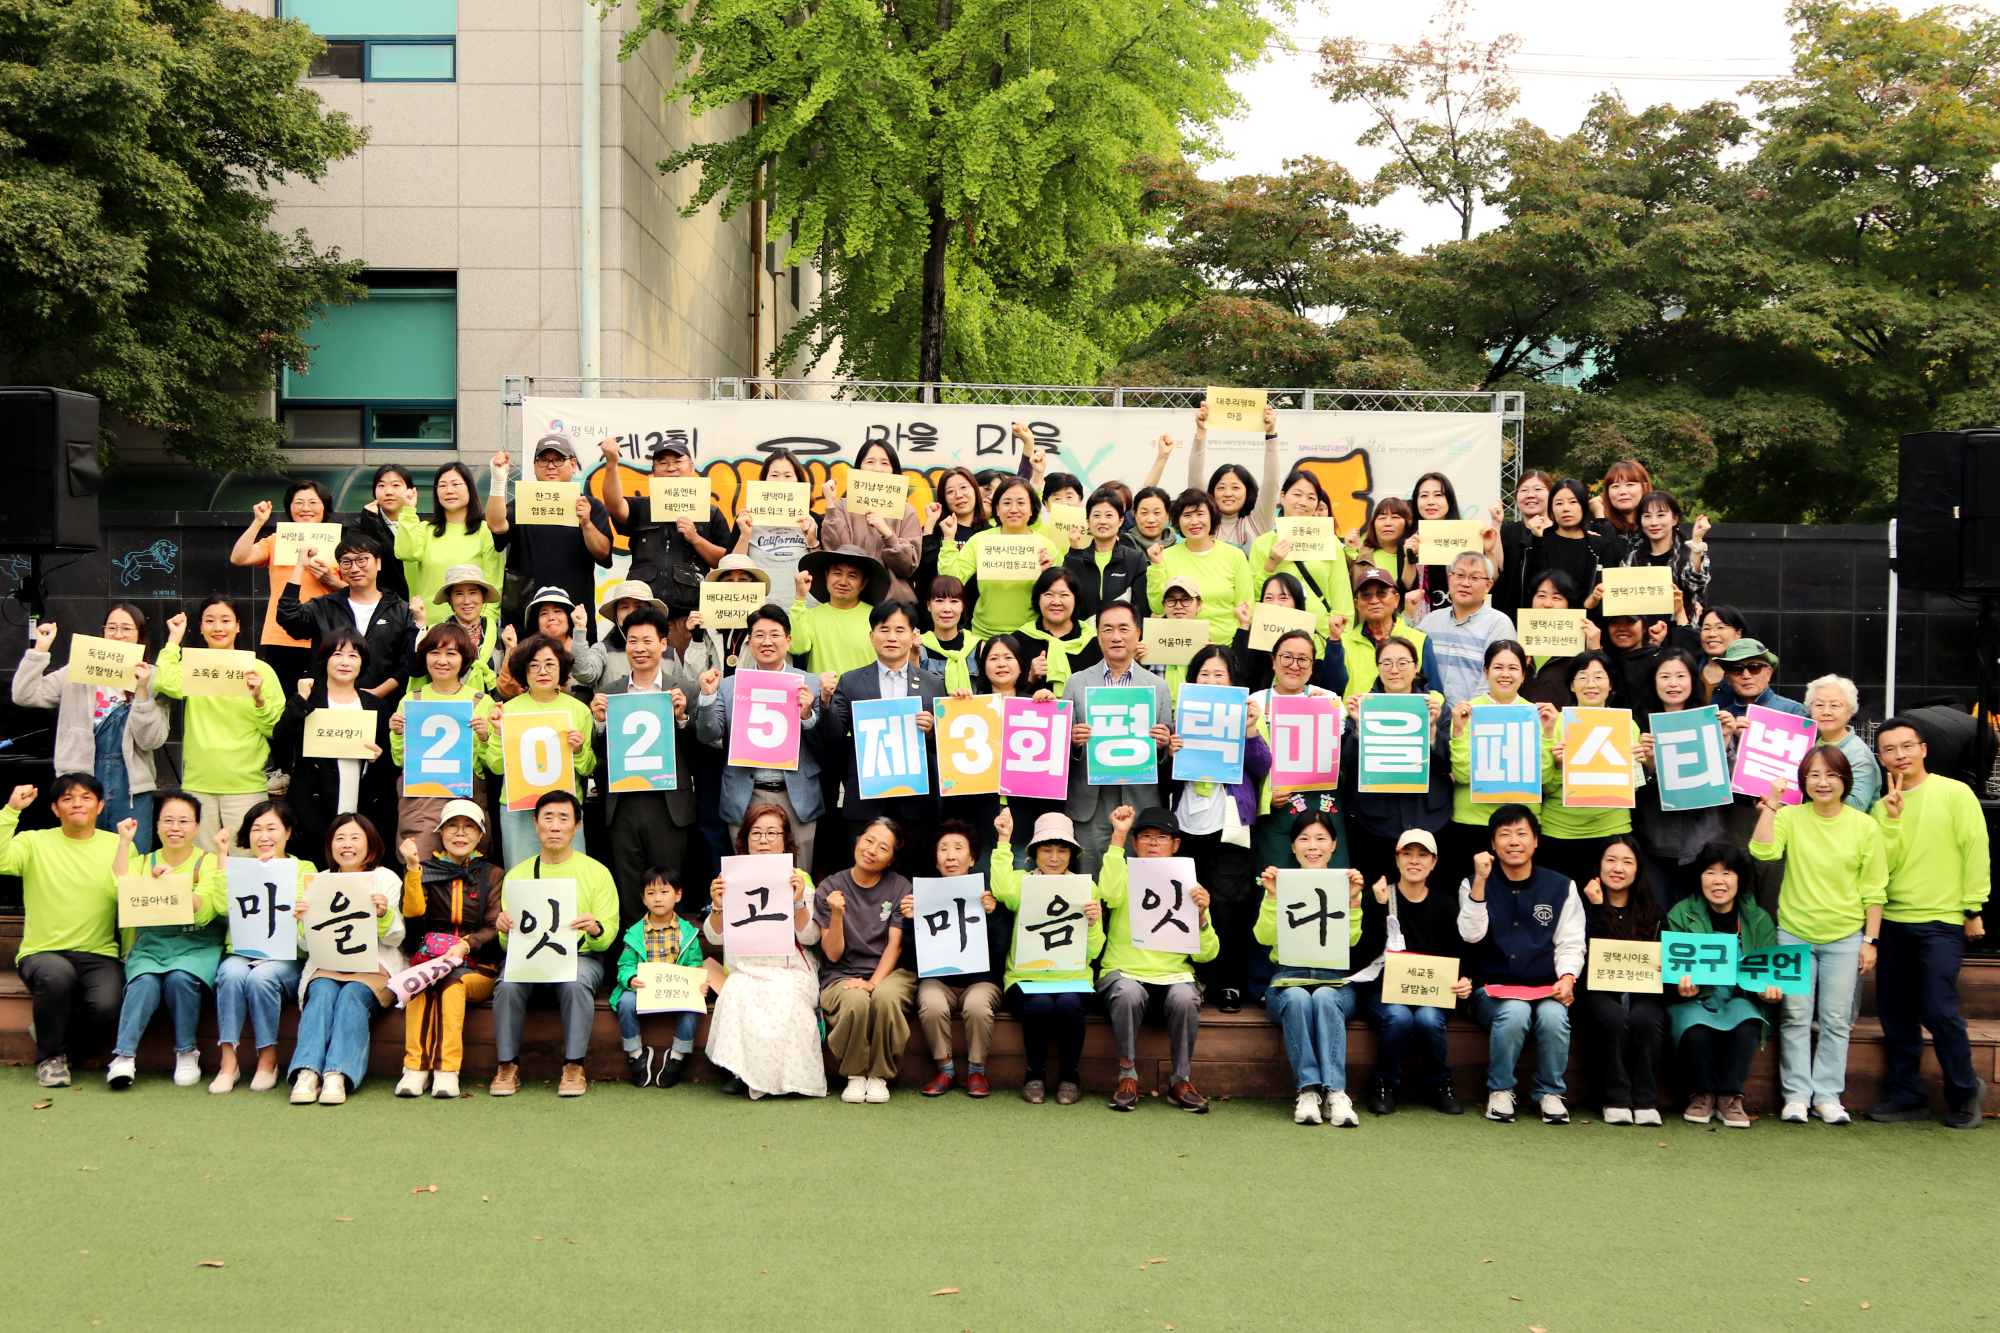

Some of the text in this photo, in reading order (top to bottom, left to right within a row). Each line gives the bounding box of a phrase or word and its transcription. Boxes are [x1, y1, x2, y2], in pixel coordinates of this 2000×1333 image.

[1216, 397, 1256, 408] 대추리평화
[1227, 412, 1243, 421] 마을
[570, 425, 608, 437] 평택시
[664, 488, 697, 497] 세움엔터
[853, 480, 901, 494] 경기남부생태
[535, 491, 560, 502] 한그릇
[761, 491, 794, 501] 평택마을
[856, 496, 894, 508] 교육연구소
[531, 506, 565, 516] 협동조합
[664, 503, 697, 512] 테인먼트
[751, 507, 805, 517] 네트워크 담소
[281, 532, 335, 542] 씨앗을 지키는
[1292, 526, 1320, 536] 공동육아
[758, 534, 807, 548] California
[1434, 538, 1468, 548] 백봉예당
[984, 545, 1035, 555] 평택시민참여
[982, 561, 1036, 570] 에너지협동조합
[706, 593, 758, 603] 배다리도서관
[1610, 586, 1665, 598] 평택기후행동
[715, 609, 749, 619] 생태지기
[1530, 619, 1574, 631] 평택시공익
[1158, 637, 1193, 647] 어울마루
[1525, 635, 1578, 646] 활동지원센터
[88, 648, 124, 663] 독립서점
[85, 664, 123, 679] 생활방식
[192, 668, 244, 680] 초록숲 상점
[747, 688, 788, 749] 5
[316, 728, 363, 740] 오로라향기
[1089, 703, 1150, 767] 평
[1181, 699, 1242, 764] 택
[421, 714, 460, 774] 2
[624, 711, 663, 771] 2
[859, 714, 921, 777] 제
[949, 713, 994, 775] 3
[1005, 710, 1066, 776] 회
[1276, 714, 1337, 778] 마
[1364, 711, 1423, 773] 을
[520, 726, 562, 786] 0
[1475, 722, 1534, 782] 페
[1569, 726, 1629, 785] 스
[1656, 723, 1725, 790] 티
[130, 895, 179, 907] 안골아낙들
[731, 886, 788, 927] 고
[1141, 879, 1191, 934] 잇
[235, 882, 291, 939] 마
[1285, 887, 1345, 947] 다
[311, 891, 371, 956] 을
[519, 898, 567, 960] 잇
[923, 897, 980, 953] 마
[1024, 894, 1083, 951] 음
[1602, 951, 1650, 965] 평택시이웃
[1668, 942, 1802, 982] 유구 무언
[654, 973, 690, 986] 공정무역
[1406, 967, 1436, 979] 세교동
[1596, 968, 1654, 981] 분쟁조정센터
[654, 989, 691, 999] 운영본부
[1400, 983, 1439, 996] 달밤놀이
